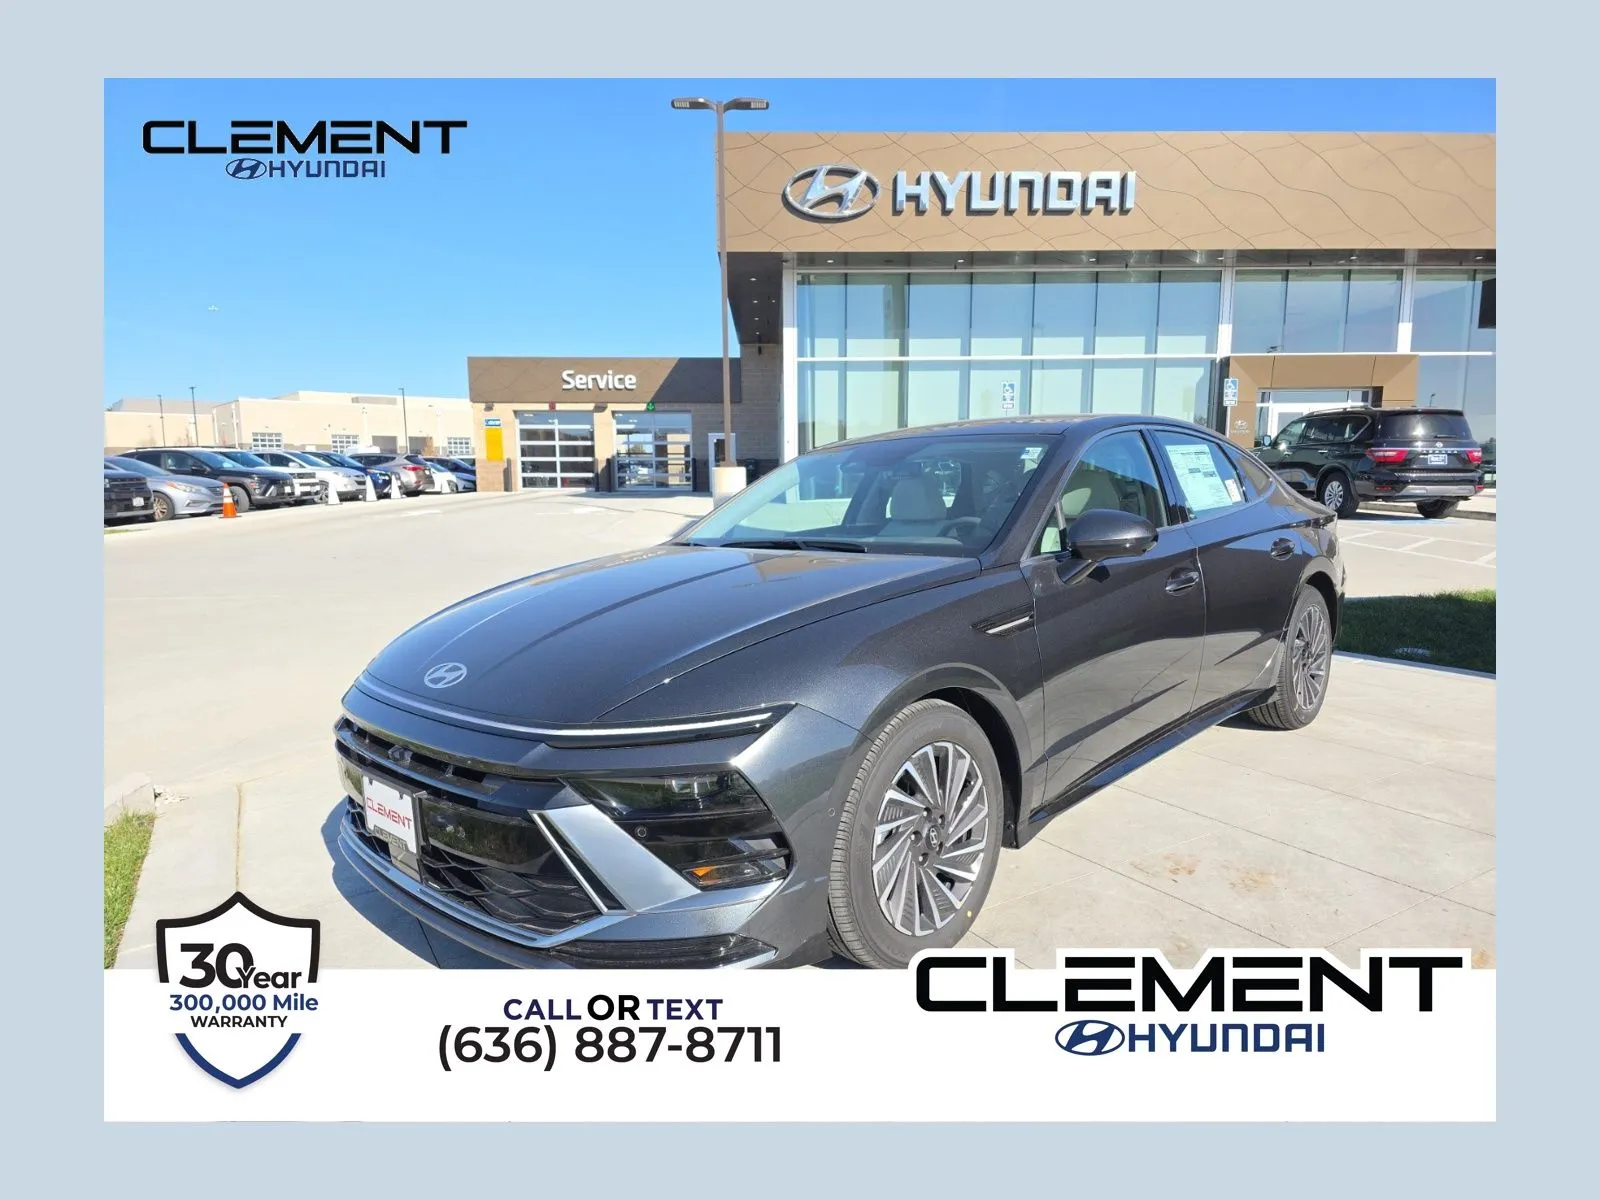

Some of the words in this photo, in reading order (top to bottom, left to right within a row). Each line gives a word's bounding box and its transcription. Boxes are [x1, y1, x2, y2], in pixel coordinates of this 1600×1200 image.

[892, 170, 1137, 216] HYUNDAI
[561, 369, 637, 391] Service
[366, 796, 412, 830] CLEMENT
